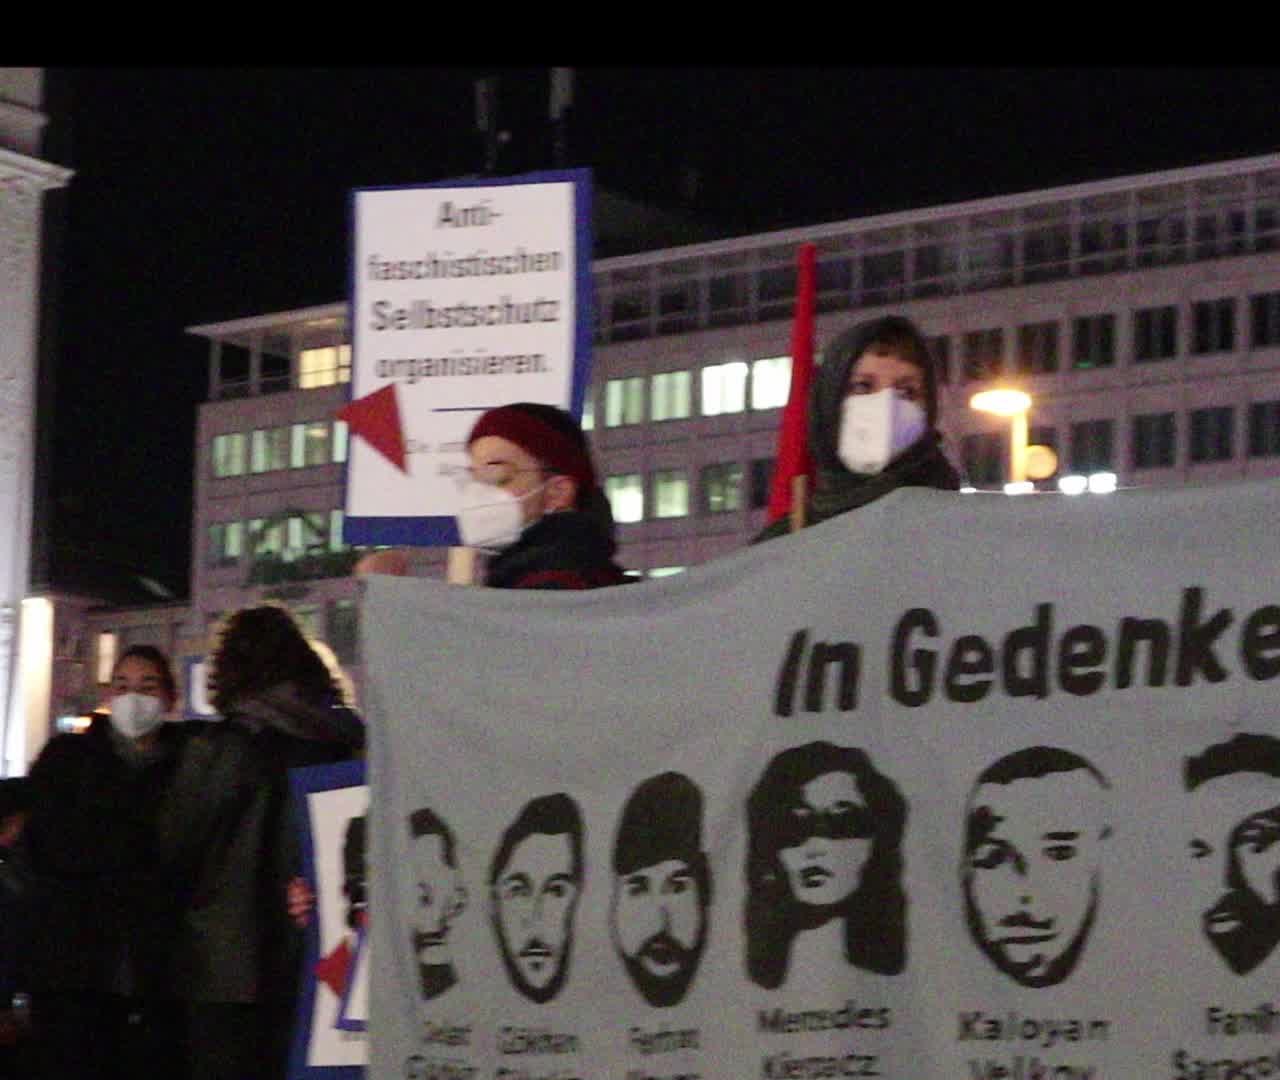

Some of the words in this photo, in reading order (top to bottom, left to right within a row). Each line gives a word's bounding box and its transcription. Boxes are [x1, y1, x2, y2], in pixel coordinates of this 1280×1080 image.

[435, 199, 503, 229] Anti-
[369, 296, 561, 332] Selbstschutz
[374, 348, 553, 385] organisieren.
[773, 626, 863, 717] In
[958, 1010, 1113, 1048] Kaloyan
